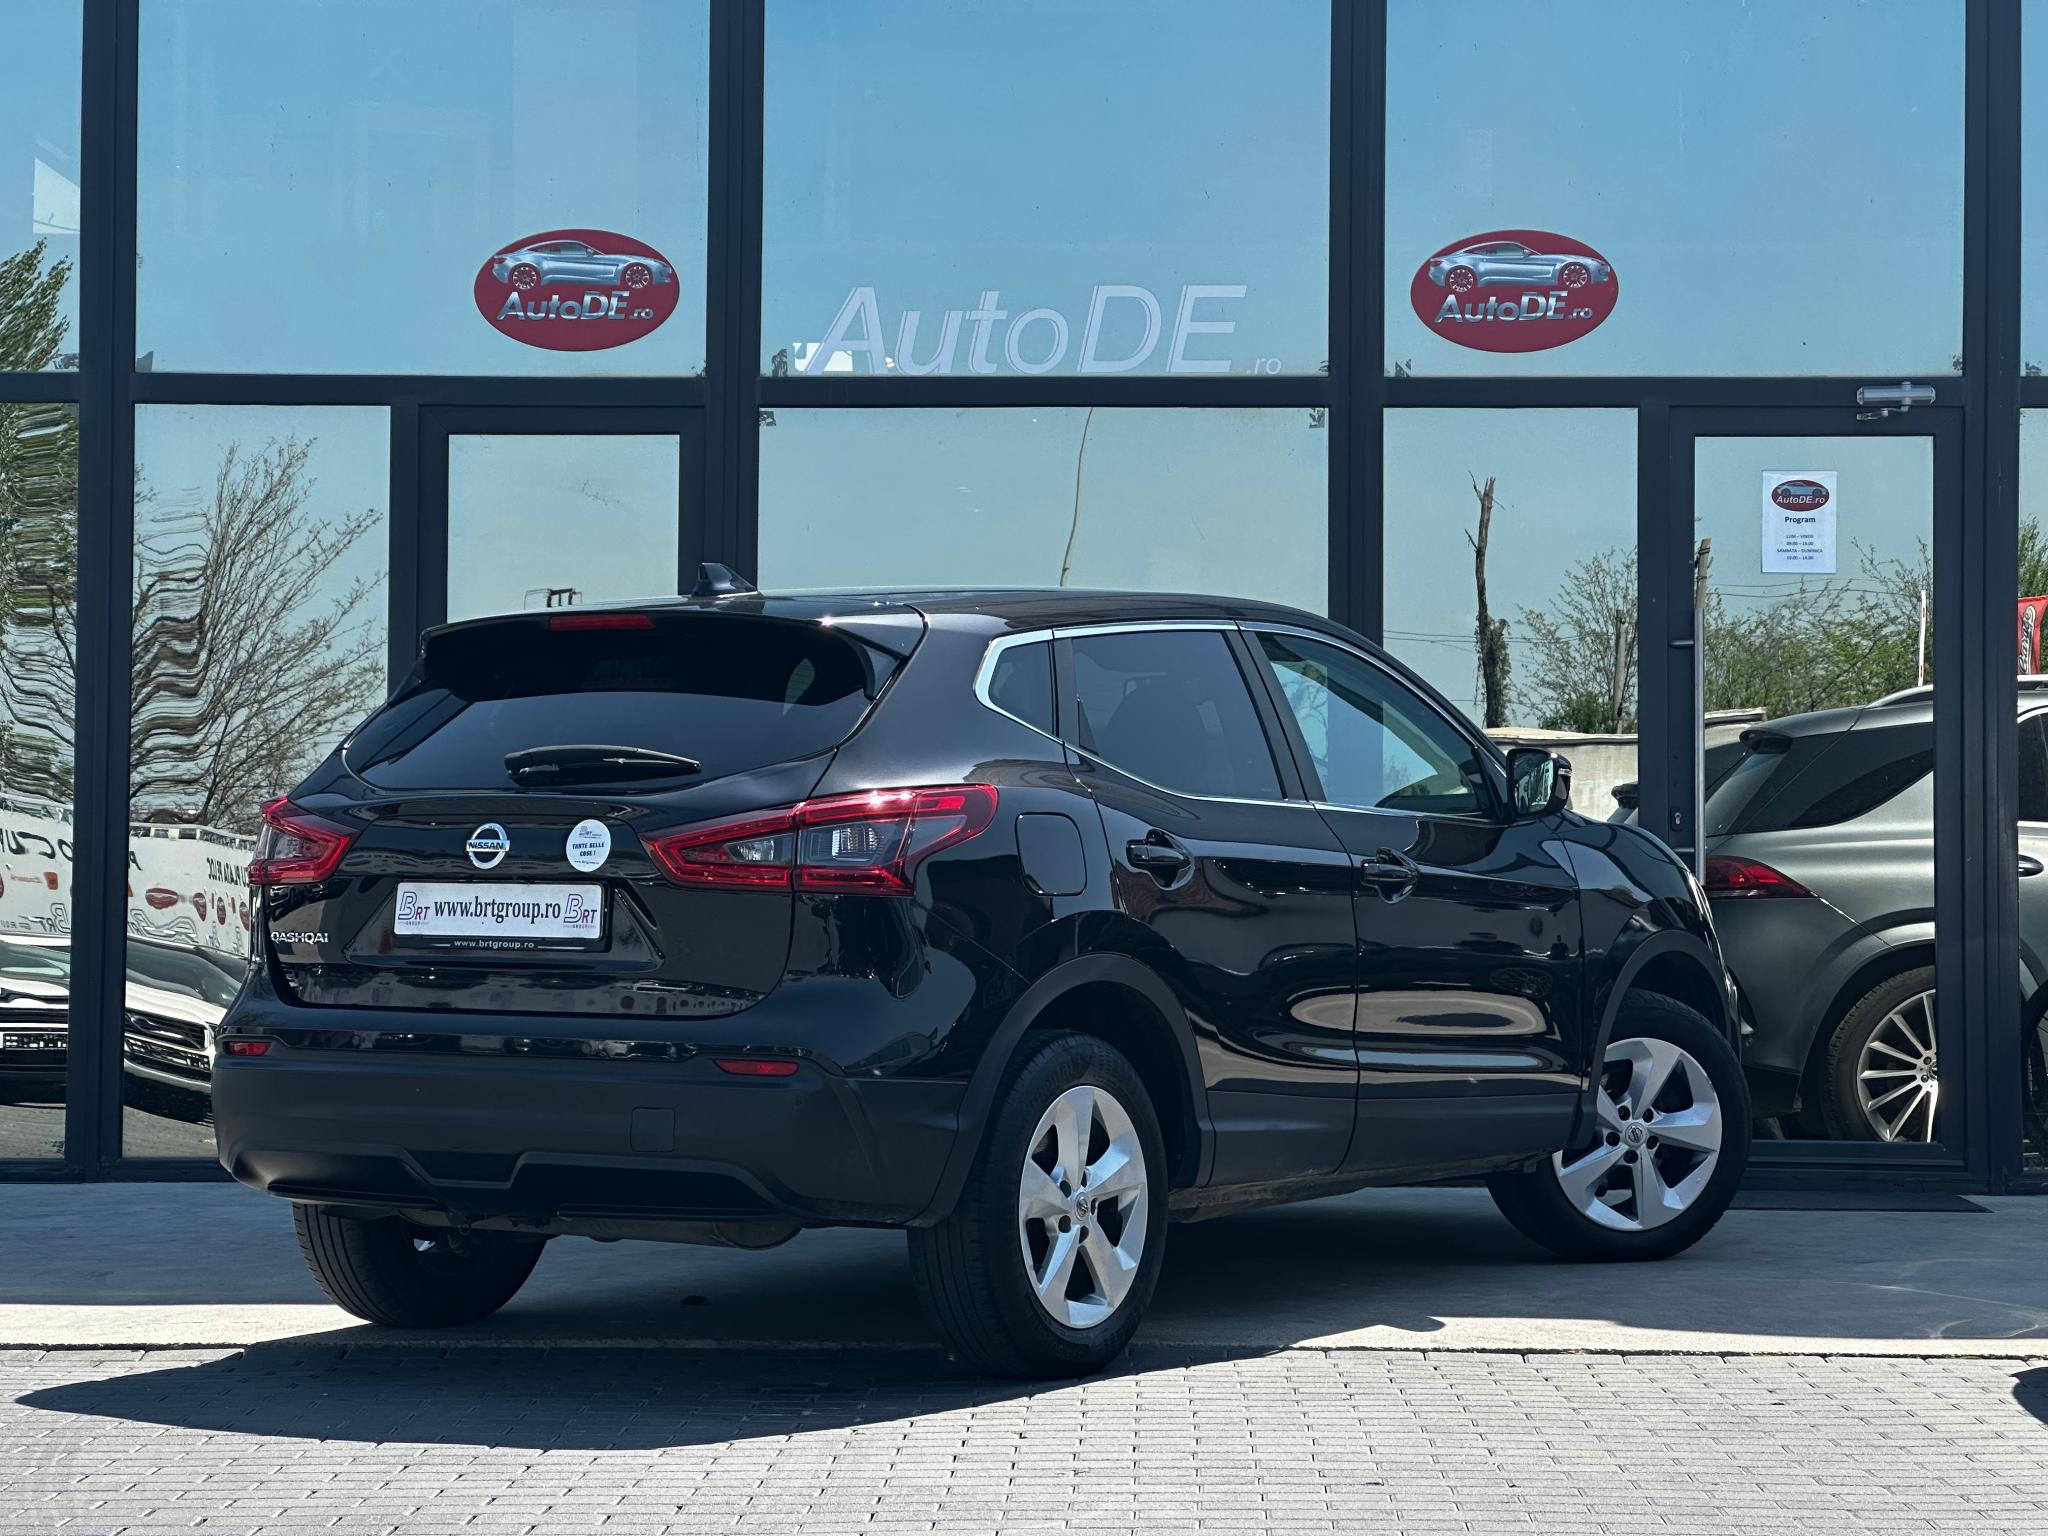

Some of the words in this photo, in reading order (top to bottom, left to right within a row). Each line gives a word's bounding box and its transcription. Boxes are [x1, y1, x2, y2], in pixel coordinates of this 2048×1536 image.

[1784, 516, 1816, 524] Program
[468, 841, 504, 850] NISSAN
[572, 842, 588, 850] TANTE
[434, 895, 561, 925] www.brtgroup.ro
[270, 931, 329, 944] QASHQAI
[453, 939, 535, 949] www.brtgroup.ro
